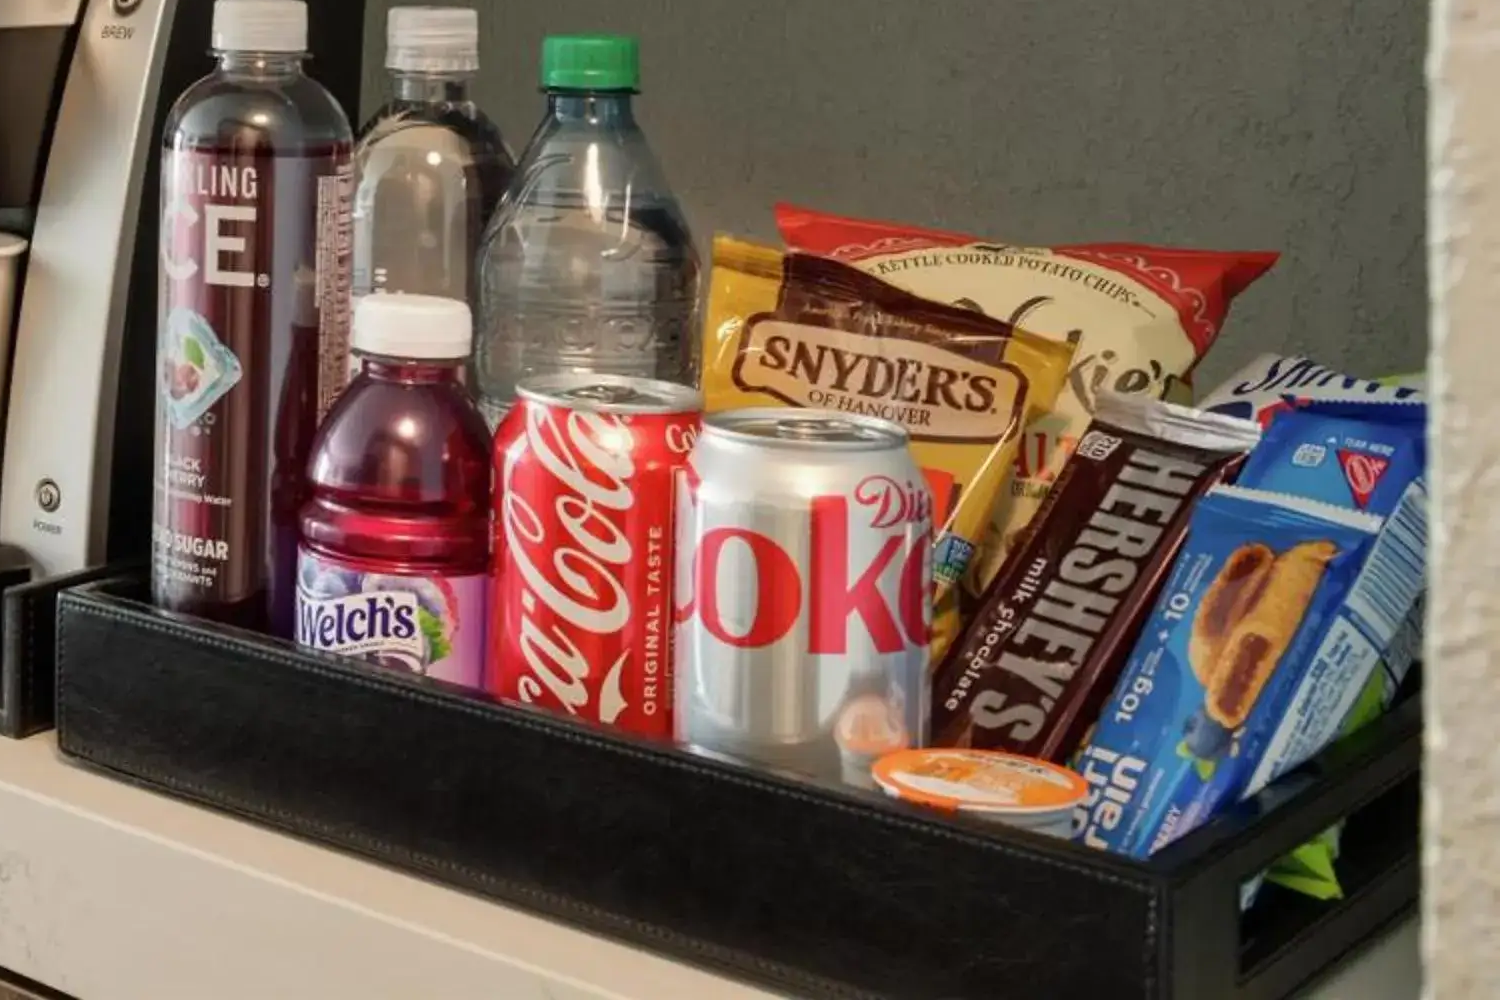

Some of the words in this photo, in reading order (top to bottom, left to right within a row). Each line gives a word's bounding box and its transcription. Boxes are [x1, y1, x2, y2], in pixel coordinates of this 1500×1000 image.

[101, 25, 135, 40] BREW
[877, 253, 943, 276] KETTLE
[946, 253, 1014, 266] COOKED
[1017, 255, 1083, 282] POTATO
[1083, 270, 1136, 303] CHIPS
[759, 335, 997, 414] SNYDER'S
[807, 390, 834, 406] OF
[837, 397, 931, 426] HANOVER
[174, 534, 229, 561] SUGAR
[647, 526, 663, 594] TASTE
[969, 448, 1206, 742] HERSHEY'S
[1011, 557, 1049, 602] milk
[300, 596, 416, 648] Welch's
[643, 604, 661, 716] ORIGINAL
[945, 604, 1016, 711] chocolate
[1115, 675, 1154, 723] 10g
